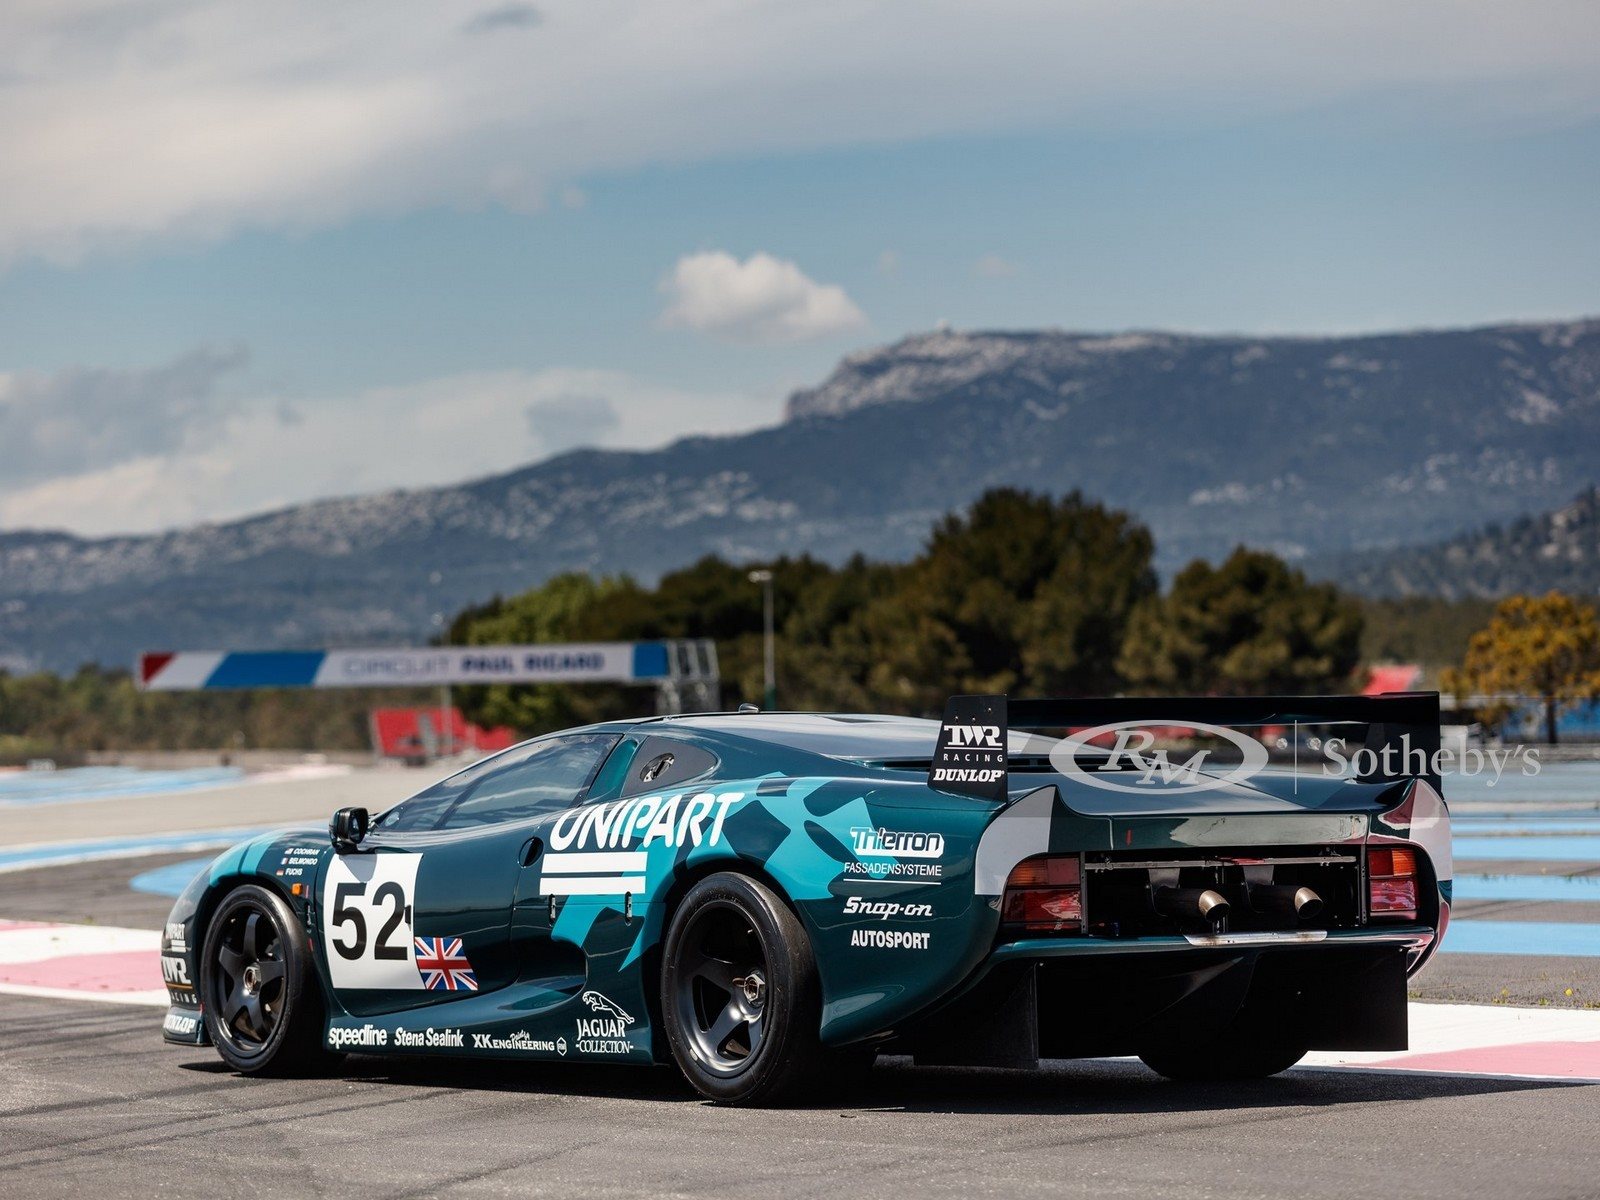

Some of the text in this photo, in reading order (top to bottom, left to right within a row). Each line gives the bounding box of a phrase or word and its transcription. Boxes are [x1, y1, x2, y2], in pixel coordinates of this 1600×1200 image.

[343, 653, 605, 675] CIRCUIT PAUL RICARD
[943, 725, 1003, 747] TWR
[943, 753, 1003, 762] RACING
[933, 768, 1005, 782] DUNLOP
[550, 792, 745, 851] UNIPART
[288, 857, 318, 865] BELMONDO
[844, 862, 942, 876] FASSADENSYSTEME
[285, 868, 303, 876] FUCHS
[843, 896, 933, 920] Snap-on
[332, 881, 408, 960] 52
[850, 930, 930, 949] AUTOSPORT
[328, 1024, 387, 1049] speedline
[394, 1026, 464, 1047] Stena Sealink
[576, 1019, 626, 1041] JAGUAR
[492, 1039, 555, 1051] ENGINEERING
